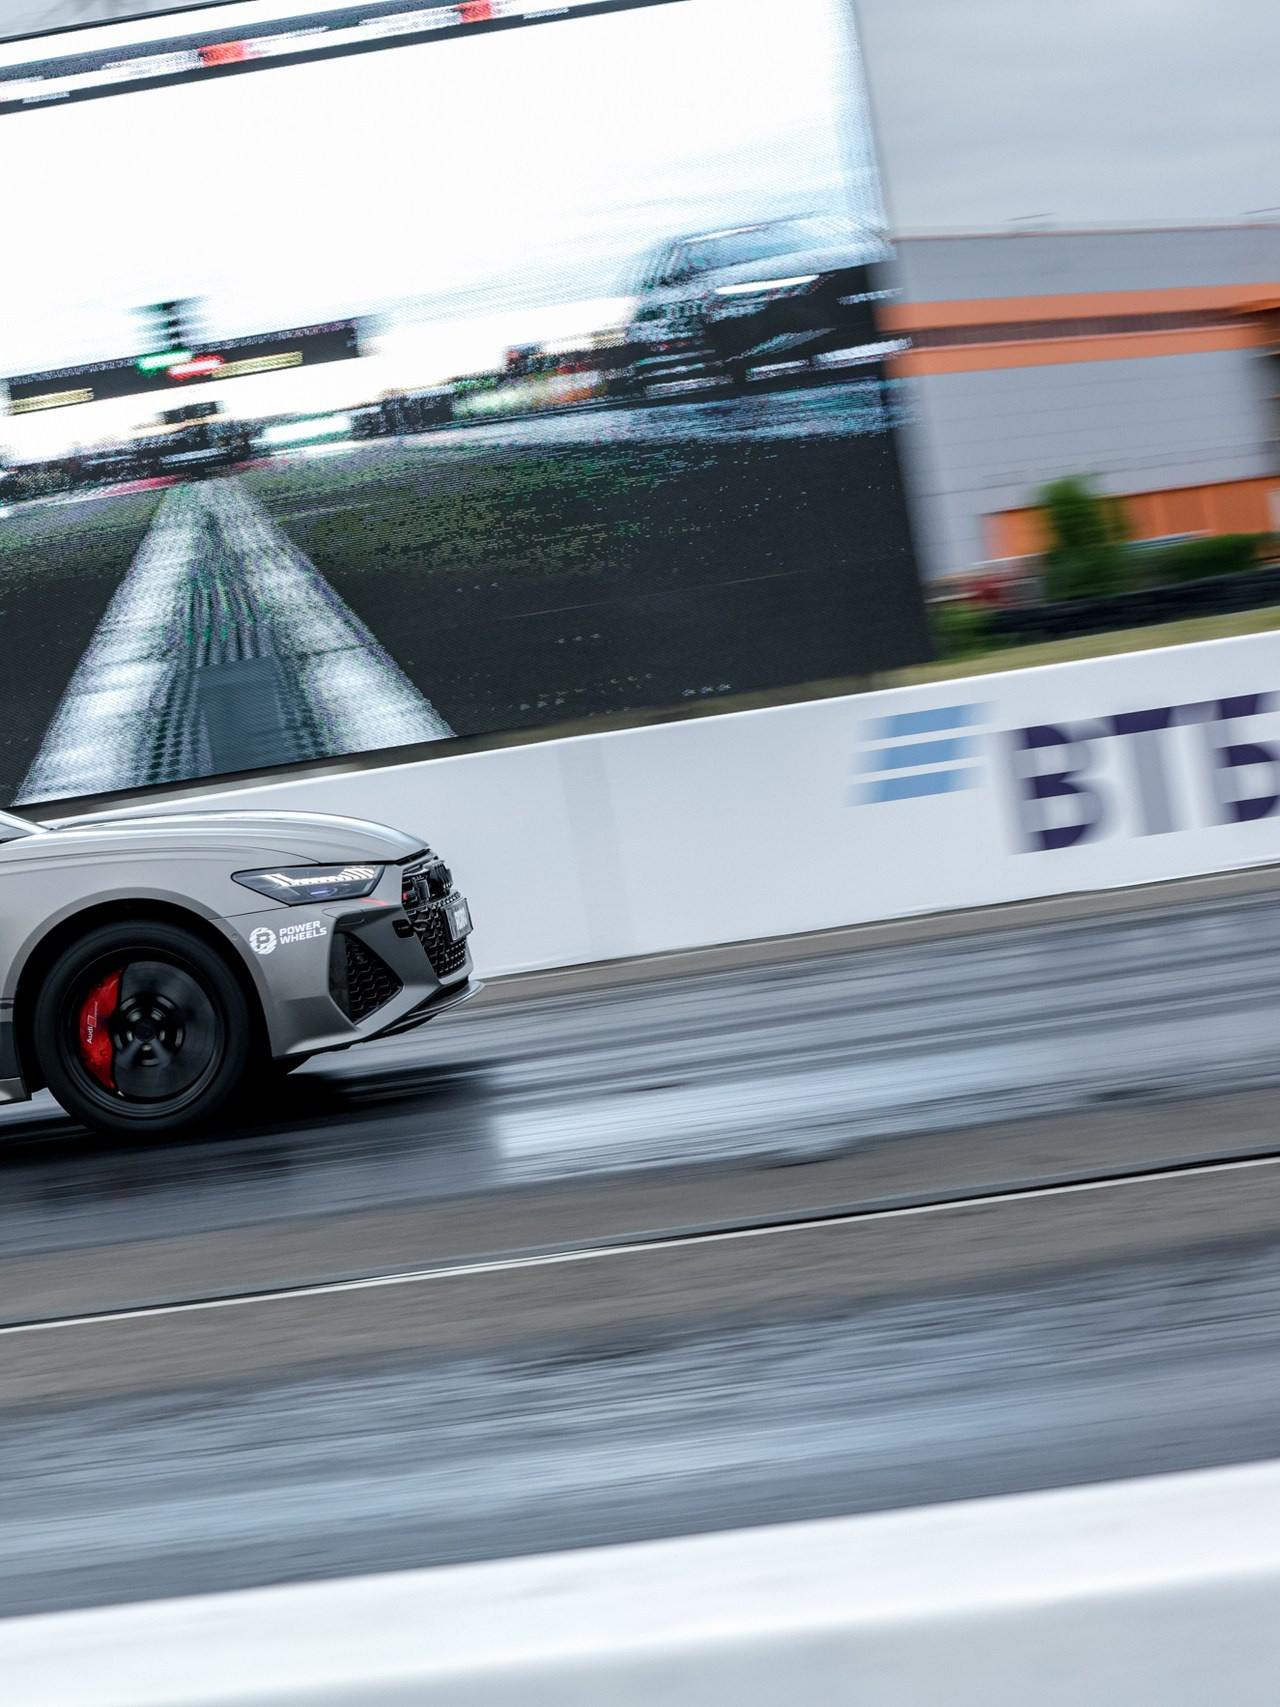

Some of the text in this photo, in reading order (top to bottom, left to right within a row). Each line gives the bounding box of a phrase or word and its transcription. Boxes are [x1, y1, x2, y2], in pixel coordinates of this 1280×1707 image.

[279, 920, 321, 937] POWER
[279, 927, 327, 945] WHEELS
[86, 1026, 94, 1044] Audi
